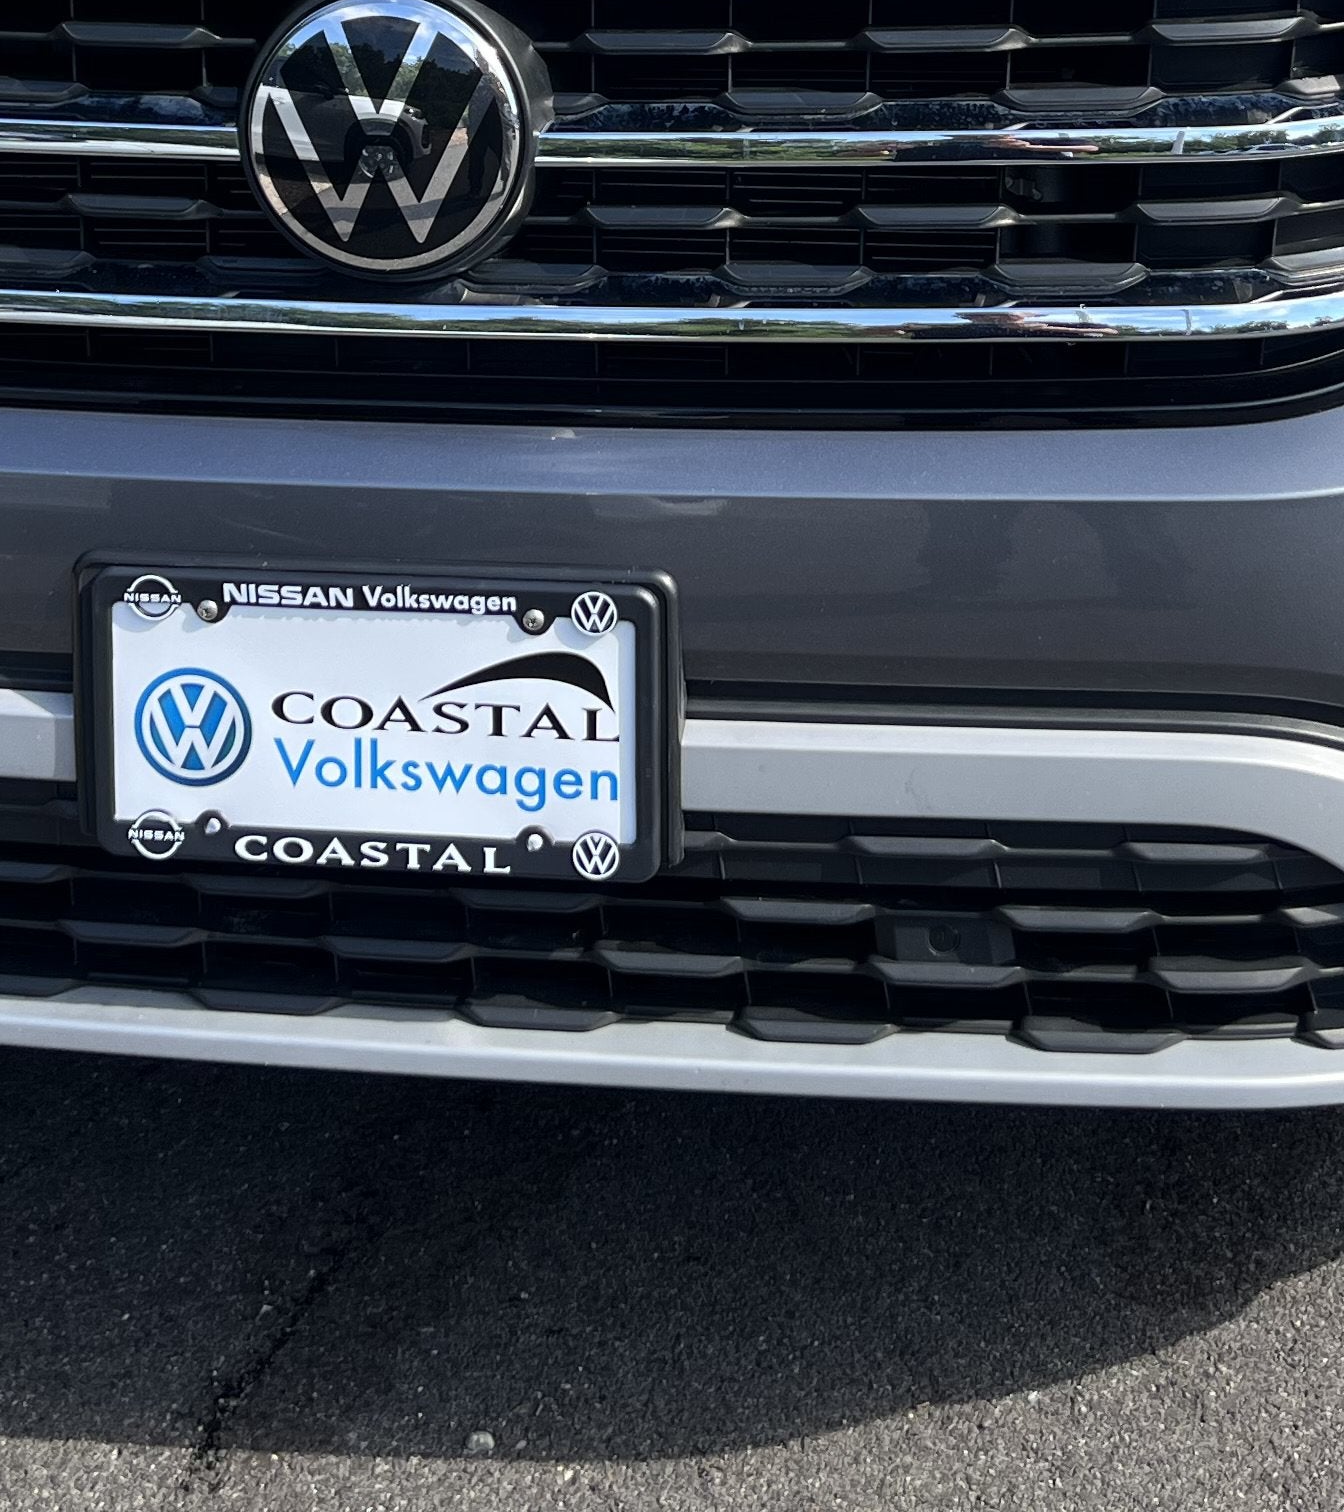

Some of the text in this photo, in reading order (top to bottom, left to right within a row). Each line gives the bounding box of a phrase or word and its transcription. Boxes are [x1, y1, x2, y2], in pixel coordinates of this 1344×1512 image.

[123, 592, 182, 603] NISSAN
[223, 582, 517, 615] NISSAN Volkswagen
[271, 690, 620, 742] COASTAL
[274, 737, 619, 812] Volkswagen
[128, 829, 185, 842] NISSAN
[234, 835, 511, 874] COASTAL
